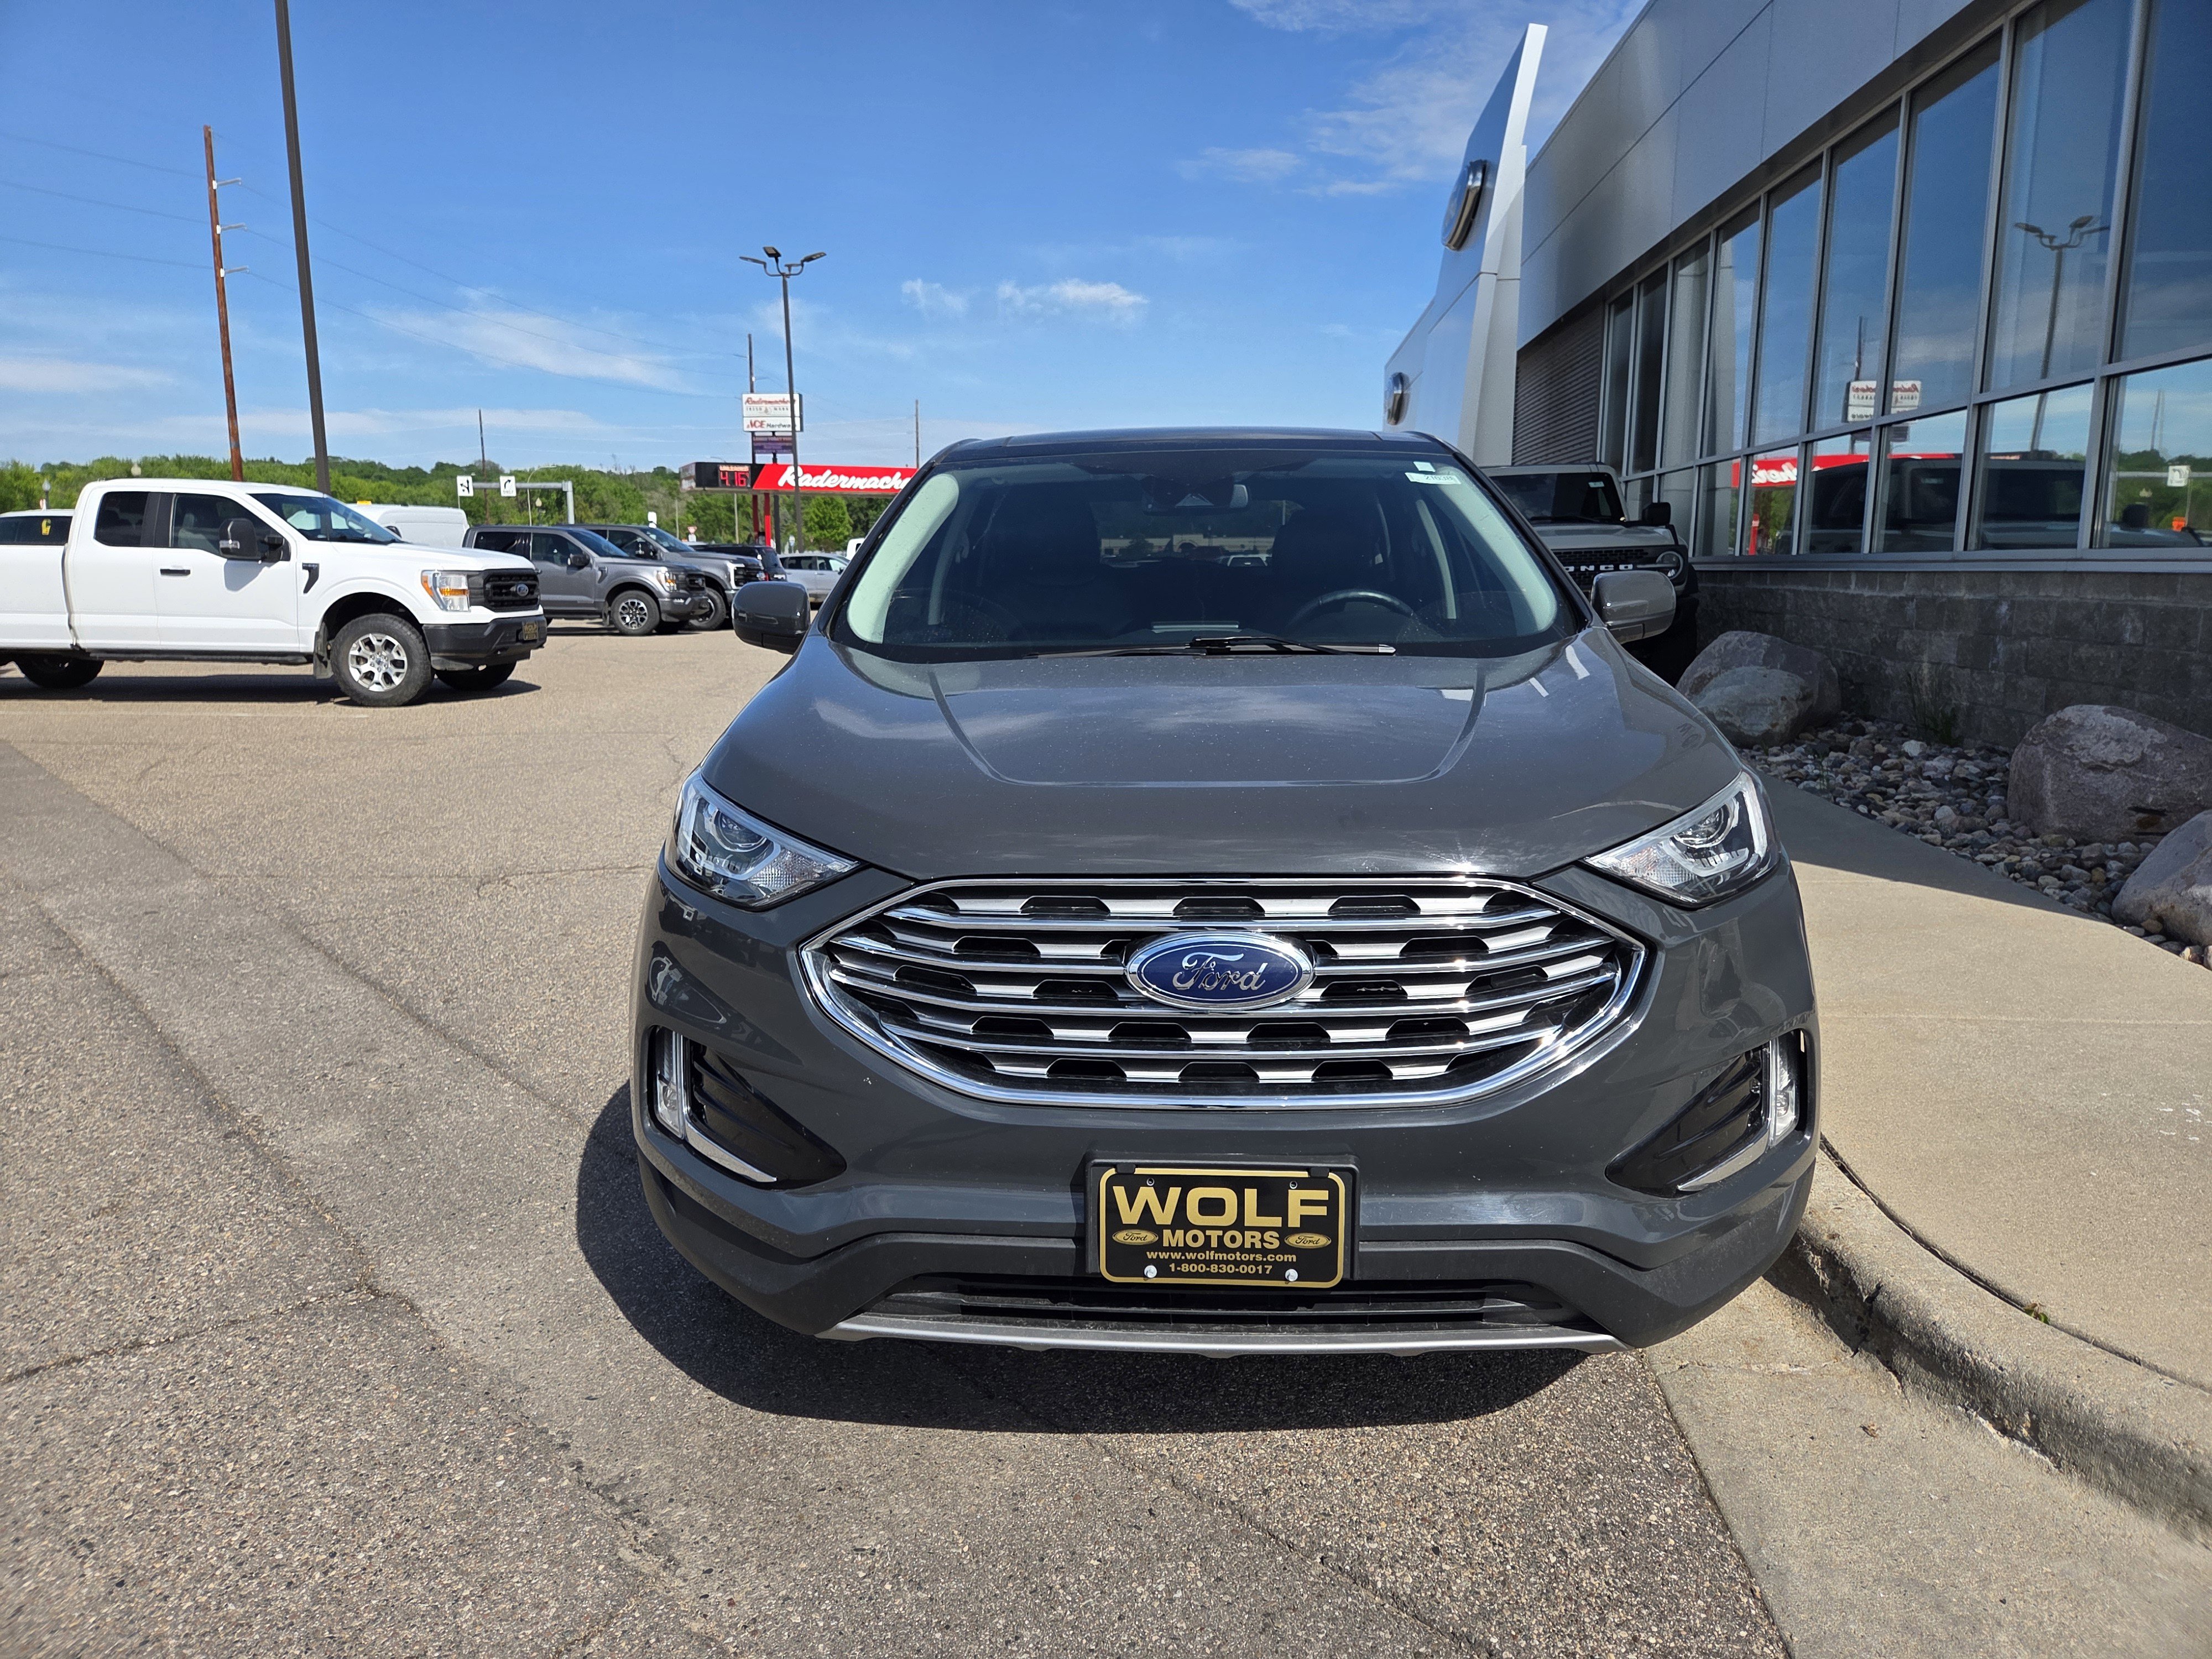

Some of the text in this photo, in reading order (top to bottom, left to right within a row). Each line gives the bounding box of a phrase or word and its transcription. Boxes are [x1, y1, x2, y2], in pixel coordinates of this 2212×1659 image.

[1172, 952, 1268, 990] Ford
[1113, 1186, 1329, 1228] WOLF
[1123, 1232, 1148, 1242] Ford
[1163, 1229, 1280, 1249] MOTORS
[1295, 1235, 1321, 1246] Ford
[1146, 1251, 1296, 1262] www.wolfmotors.com
[1169, 1263, 1273, 1275] 1-800-830-0017
